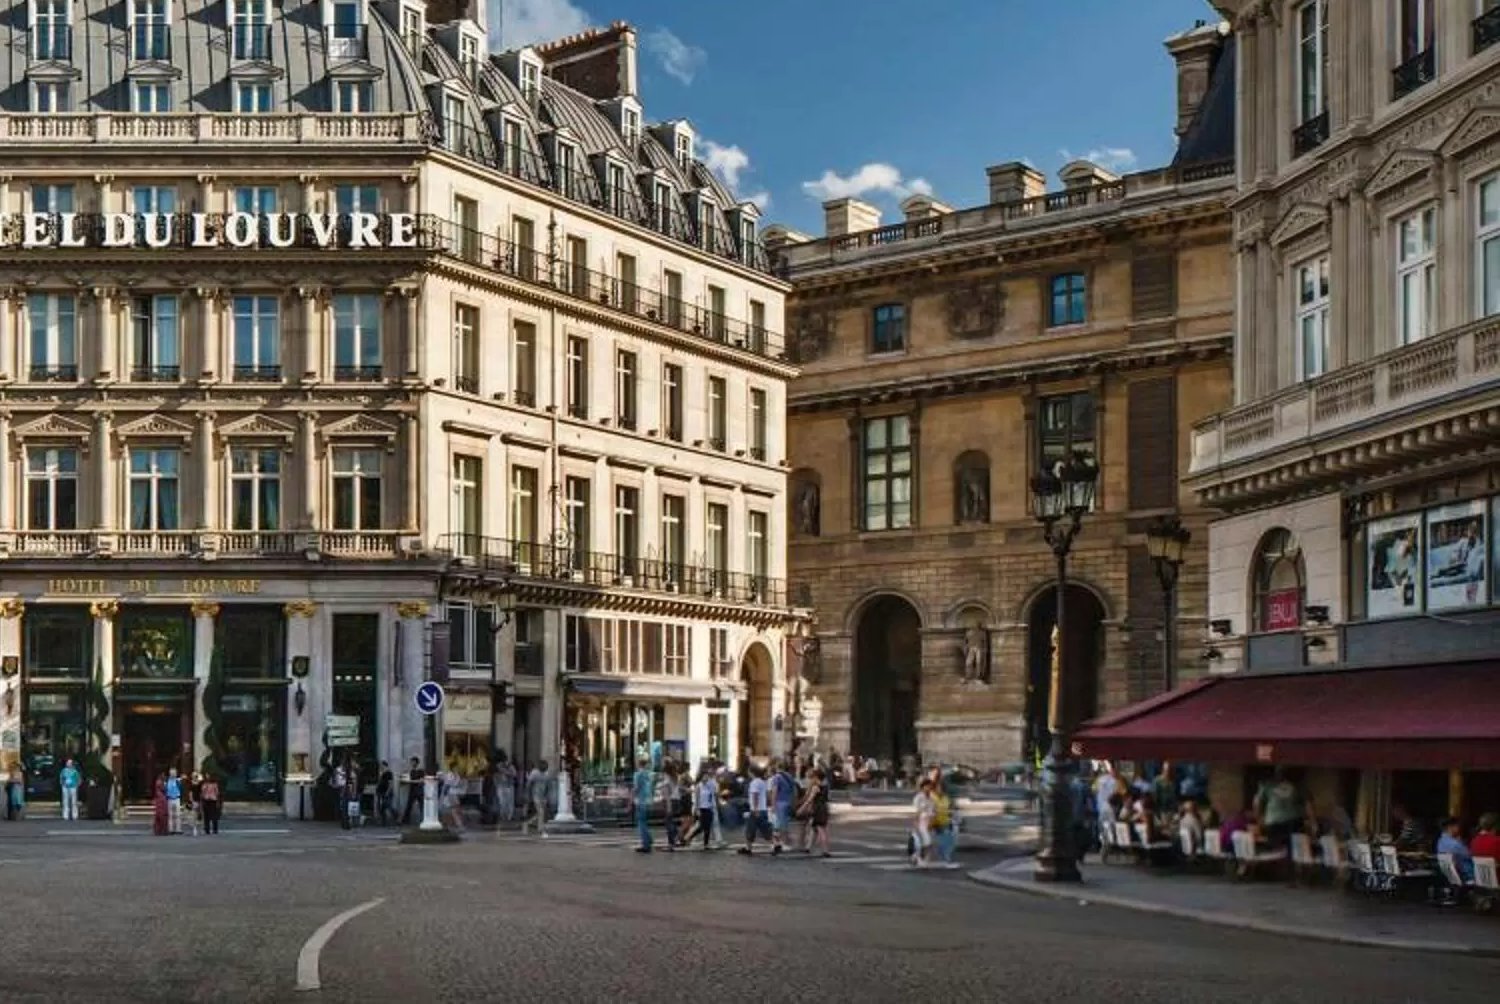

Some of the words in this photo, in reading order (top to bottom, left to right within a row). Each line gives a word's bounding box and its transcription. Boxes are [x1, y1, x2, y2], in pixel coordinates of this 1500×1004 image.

[102, 212, 174, 247] DU
[191, 212, 418, 247] LOUVRE
[181, 579, 261, 594] LOUVRE
